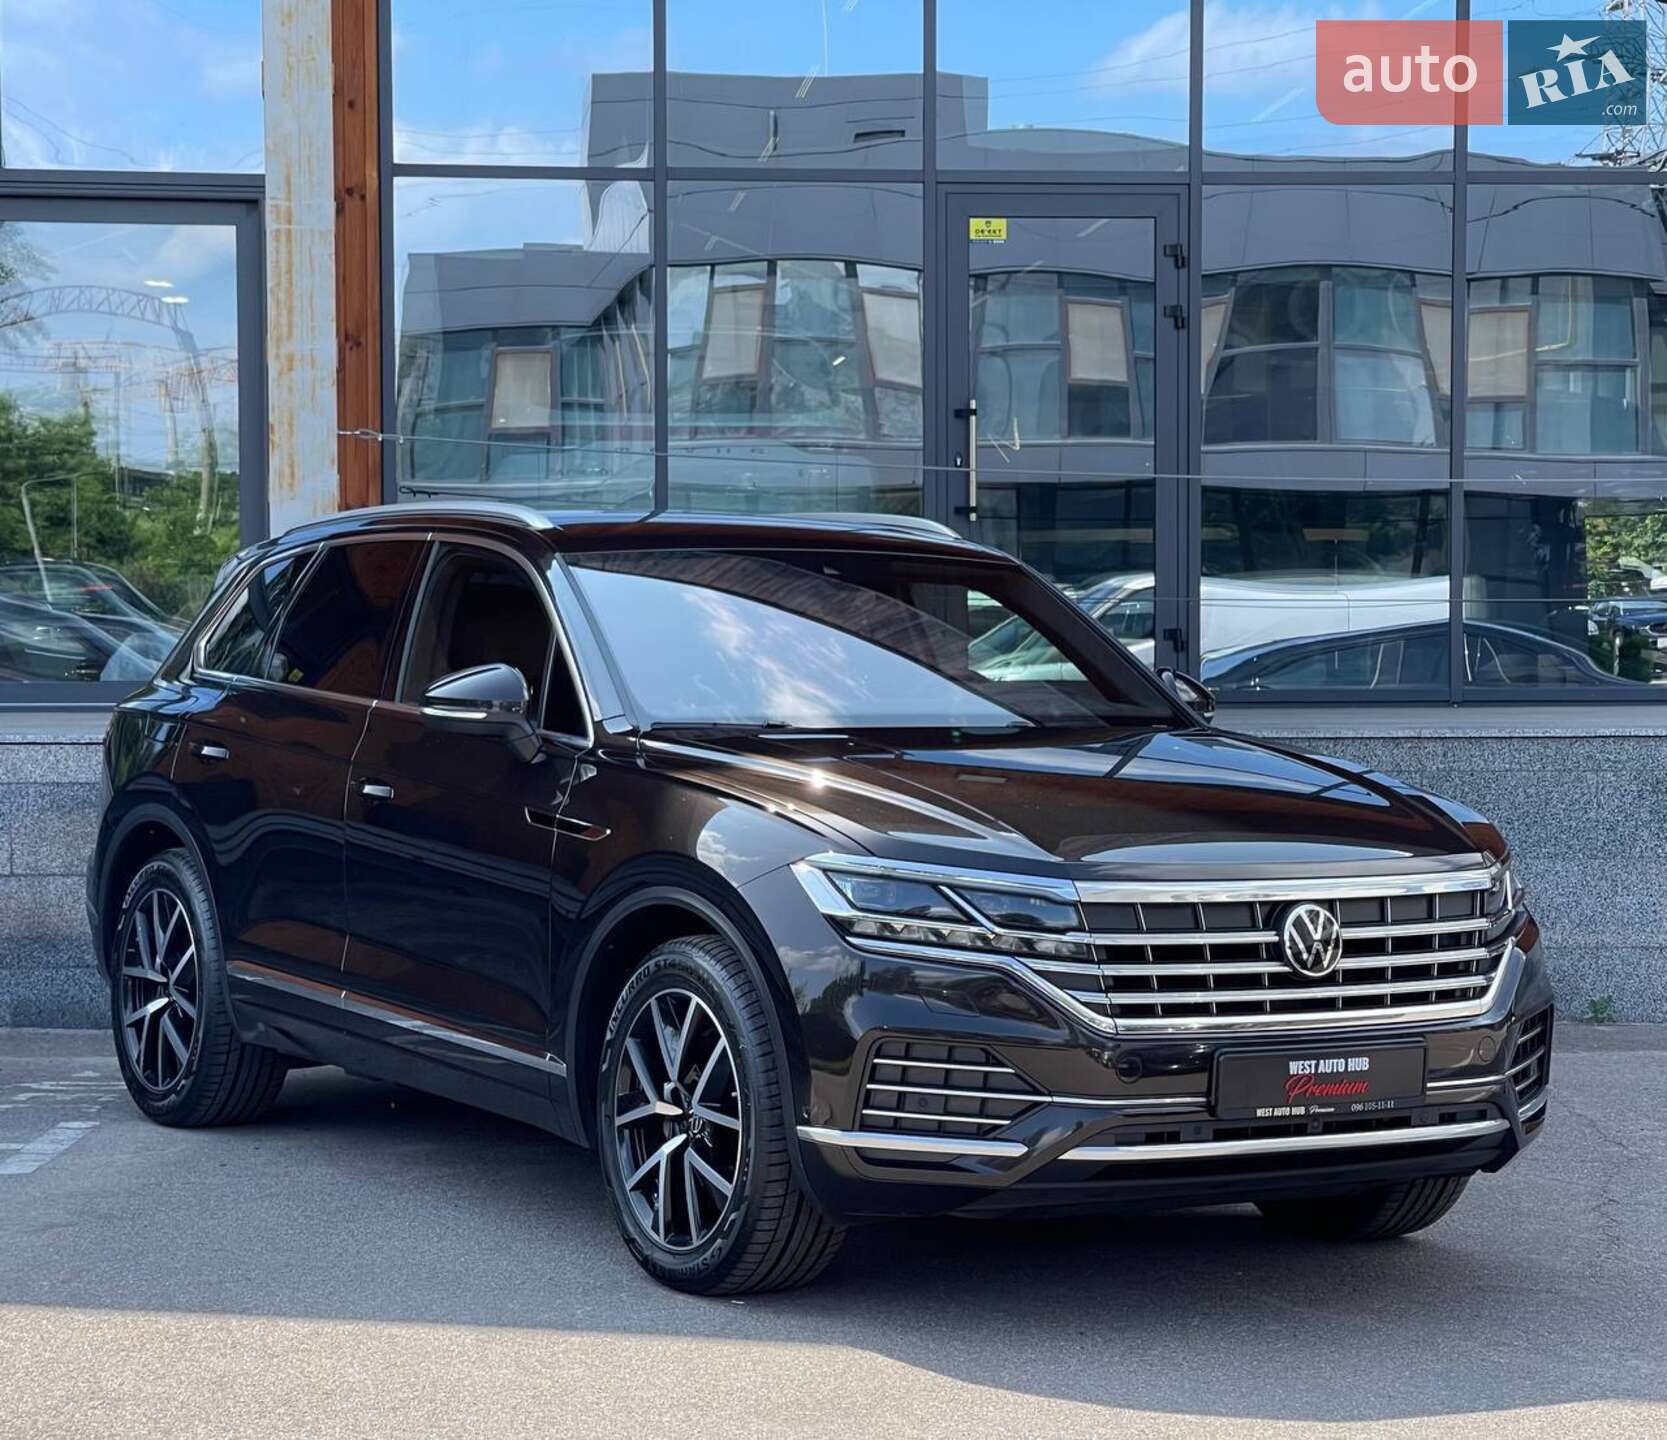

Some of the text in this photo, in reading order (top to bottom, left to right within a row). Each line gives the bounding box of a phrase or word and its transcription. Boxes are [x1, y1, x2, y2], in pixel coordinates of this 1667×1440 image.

[1288, 1056, 1370, 1075] WEST AUTO HUB
[1284, 1073, 1370, 1104] Premium
[1256, 1107, 1274, 1117] WEST
[1274, 1106, 1291, 1116] AUTO
